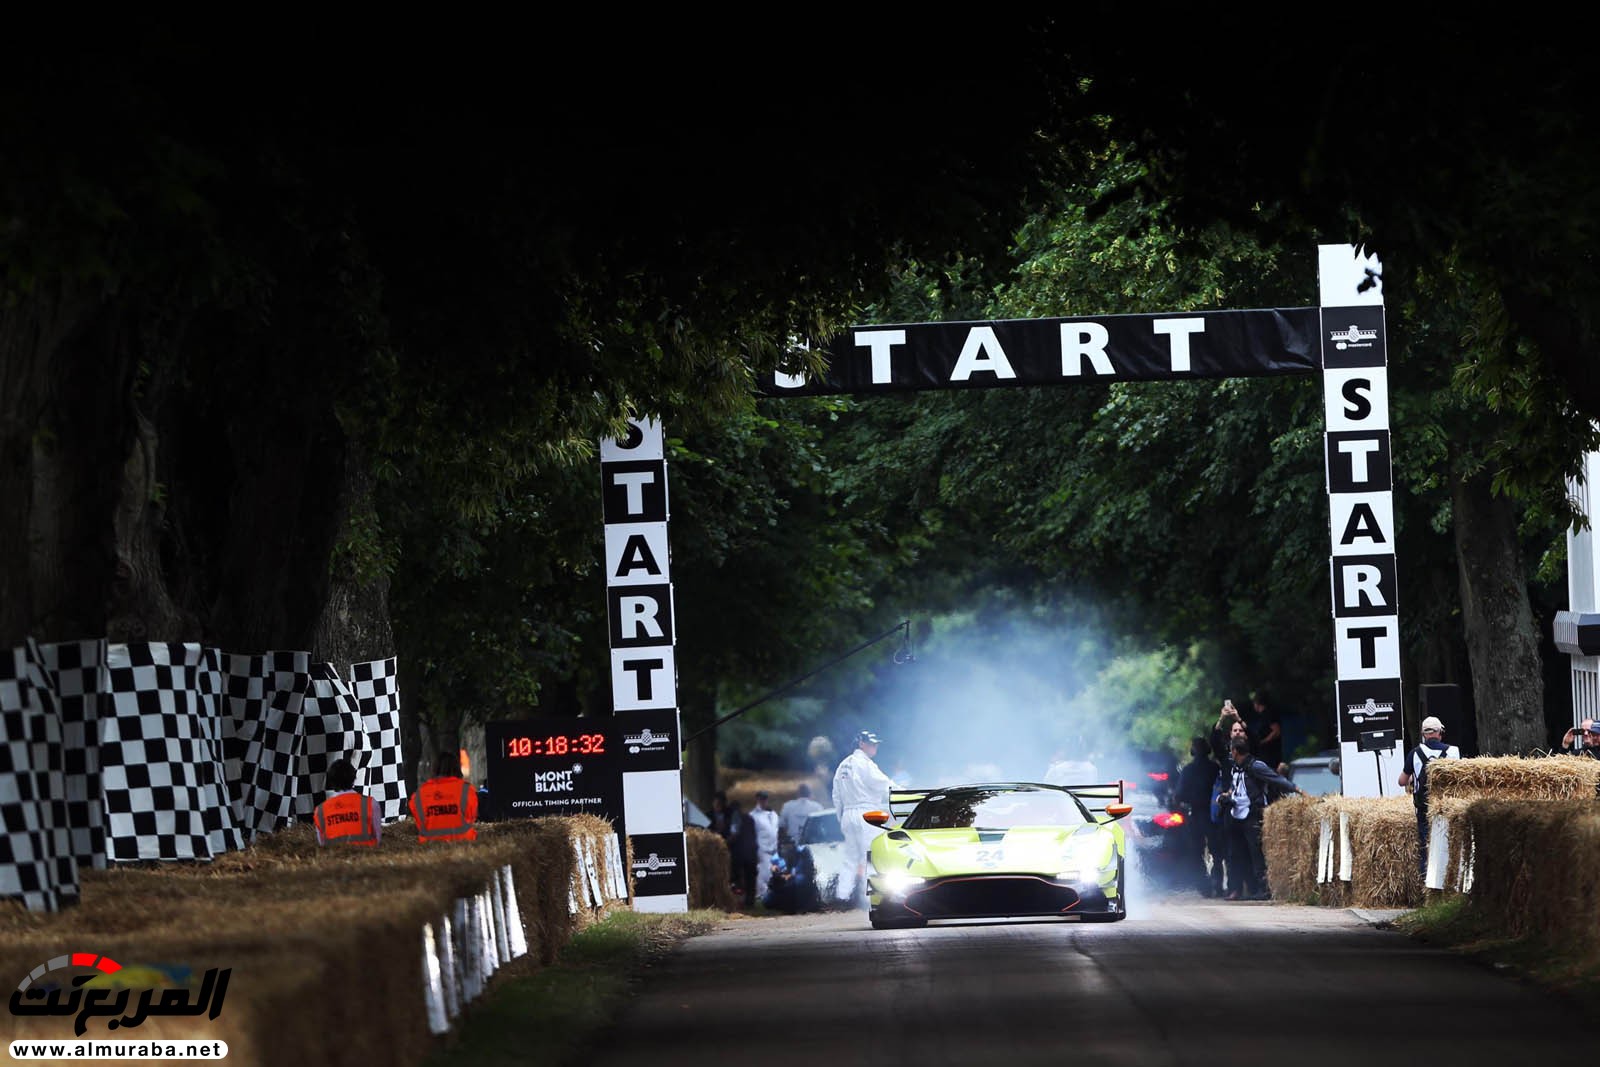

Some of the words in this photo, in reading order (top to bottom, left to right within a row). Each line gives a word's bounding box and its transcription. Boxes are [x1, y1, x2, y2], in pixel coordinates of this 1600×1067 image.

[1338, 377, 1387, 670] START
[508, 734, 605, 757] 10:18:32
[534, 770, 573, 782] MONT
[535, 781, 574, 793] BLANC
[512, 800, 543, 808] OFFICIAL
[570, 797, 602, 805] PARTNER
[426, 804, 458, 817] STEWARD
[327, 811, 359, 826] STEWARD
[976, 850, 1004, 862] 24
